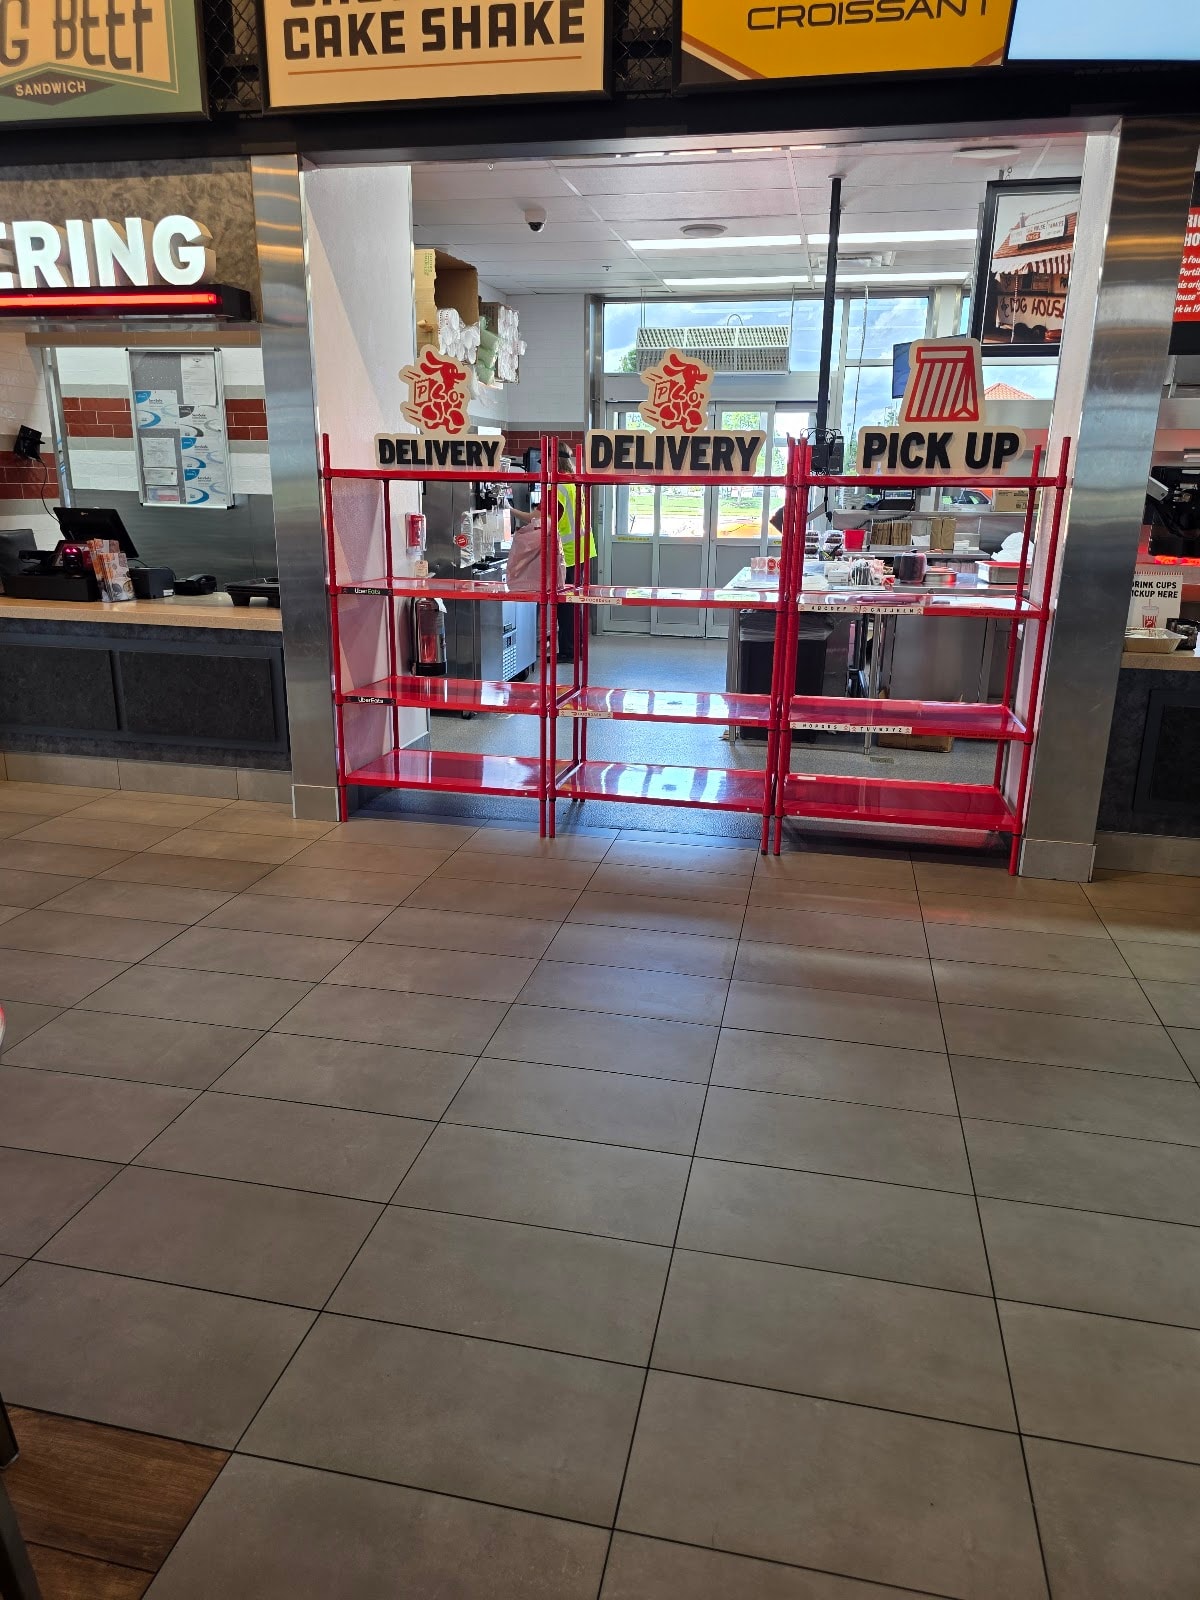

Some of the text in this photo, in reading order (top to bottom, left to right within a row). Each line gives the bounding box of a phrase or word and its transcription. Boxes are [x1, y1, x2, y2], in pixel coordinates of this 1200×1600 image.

[283, 0, 585, 60] CAKE SHAKE
[15, 80, 87, 97] SANDWICH
[1010, 297, 1028, 313] DOG
[378, 438, 500, 467] DELIVERY
[590, 434, 761, 472] DELIVERY
[862, 431, 1020, 469] PICK UP
[1131, 590, 1178, 599] ICKUP HERE
[1155, 581, 1177, 589] CUPS
